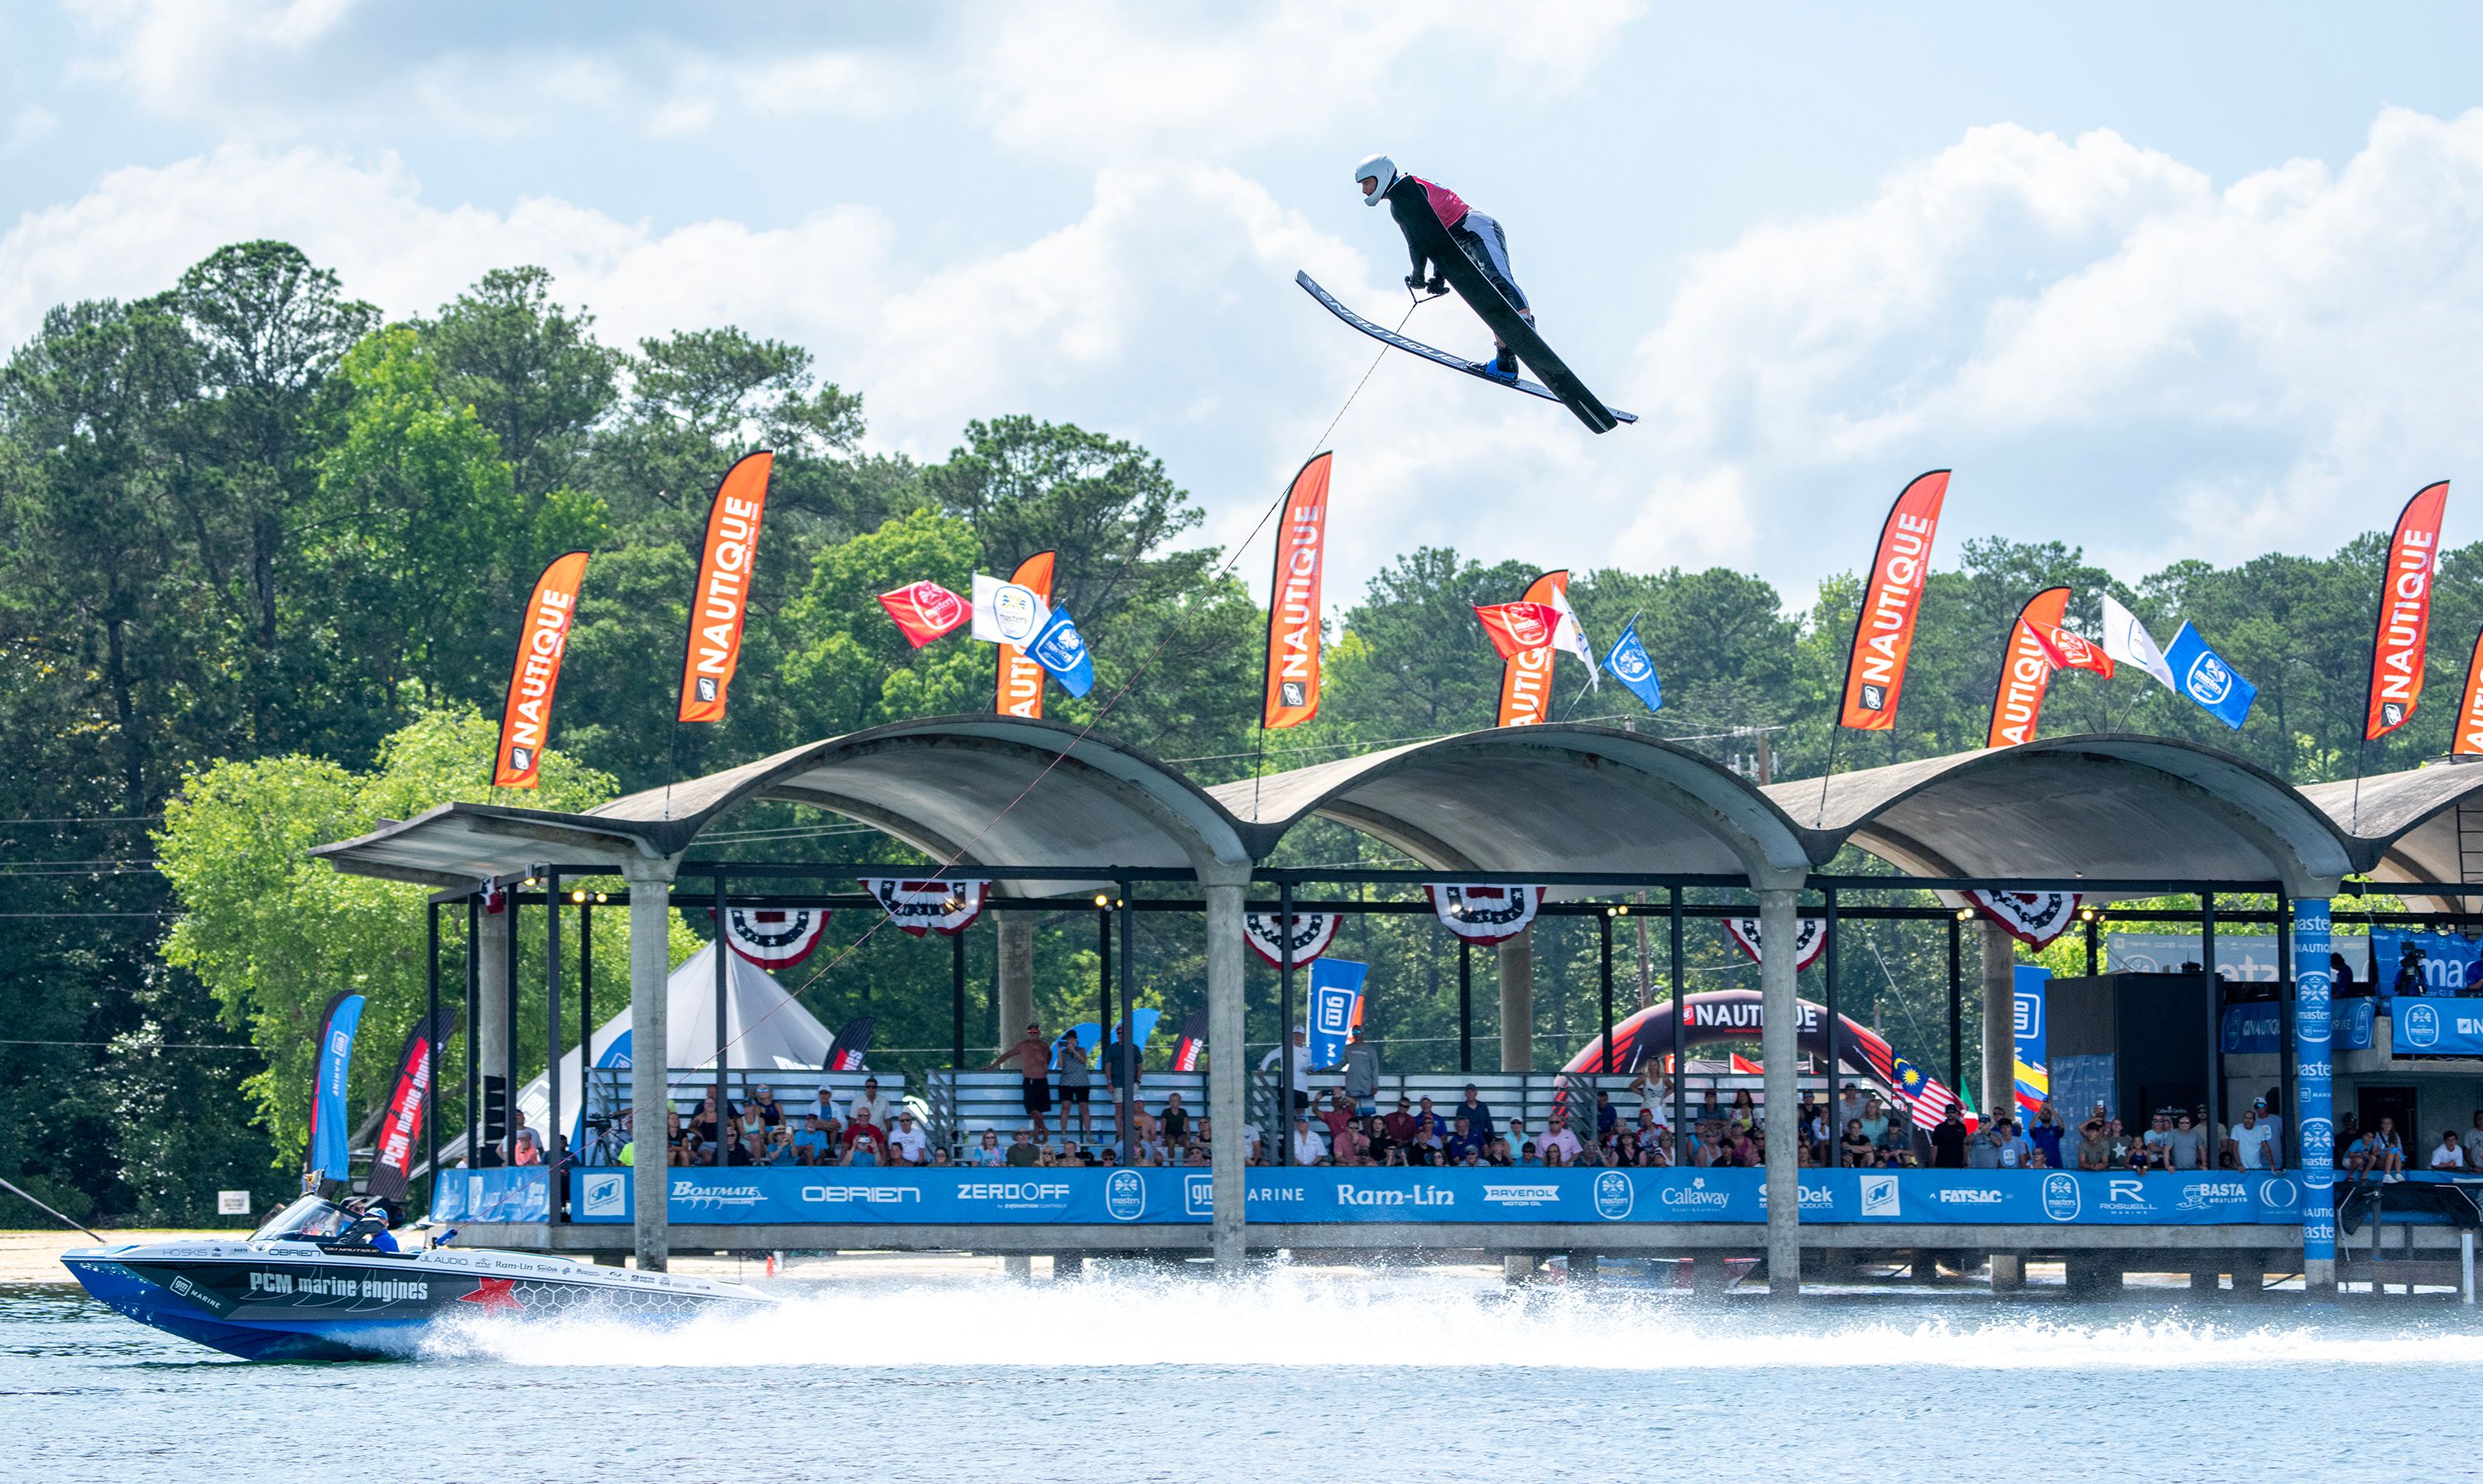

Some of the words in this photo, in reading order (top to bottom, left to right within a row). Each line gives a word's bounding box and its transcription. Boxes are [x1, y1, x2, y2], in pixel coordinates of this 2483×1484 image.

[1329, 301, 1466, 365] NAUTIQUE
[697, 497, 752, 674] NAUTIQUE
[1281, 506, 1318, 678] NAUTIQUE
[924, 597, 954, 618] masters
[1862, 512, 1928, 683] NAUTIQUE
[999, 613, 1027, 624] masters
[2381, 530, 2433, 699] NAUTIQUE
[512, 588, 569, 745] NAUTIQUE
[1325, 996, 1345, 1027] gm
[382, 1133, 410, 1169] PCM
[397, 1088, 421, 1133] marine
[672, 1181, 758, 1195] BOATMATE
[801, 1185, 920, 1203] OBRIEN
[1337, 1184, 1454, 1205] Ram-Lin
[1662, 1187, 1730, 1208] Callaway
[1940, 1189, 2002, 1203] FATSAC
[2200, 1183, 2246, 1197] BASTA
[269, 1248, 320, 1257] OBRIEN
[496, 1261, 533, 1270] Ram-Lin
[175, 1280, 189, 1292] gm
[250, 1271, 292, 1294] PCM
[298, 1277, 357, 1298] marine
[362, 1279, 428, 1303] engines
[190, 1289, 222, 1309] MARINE
